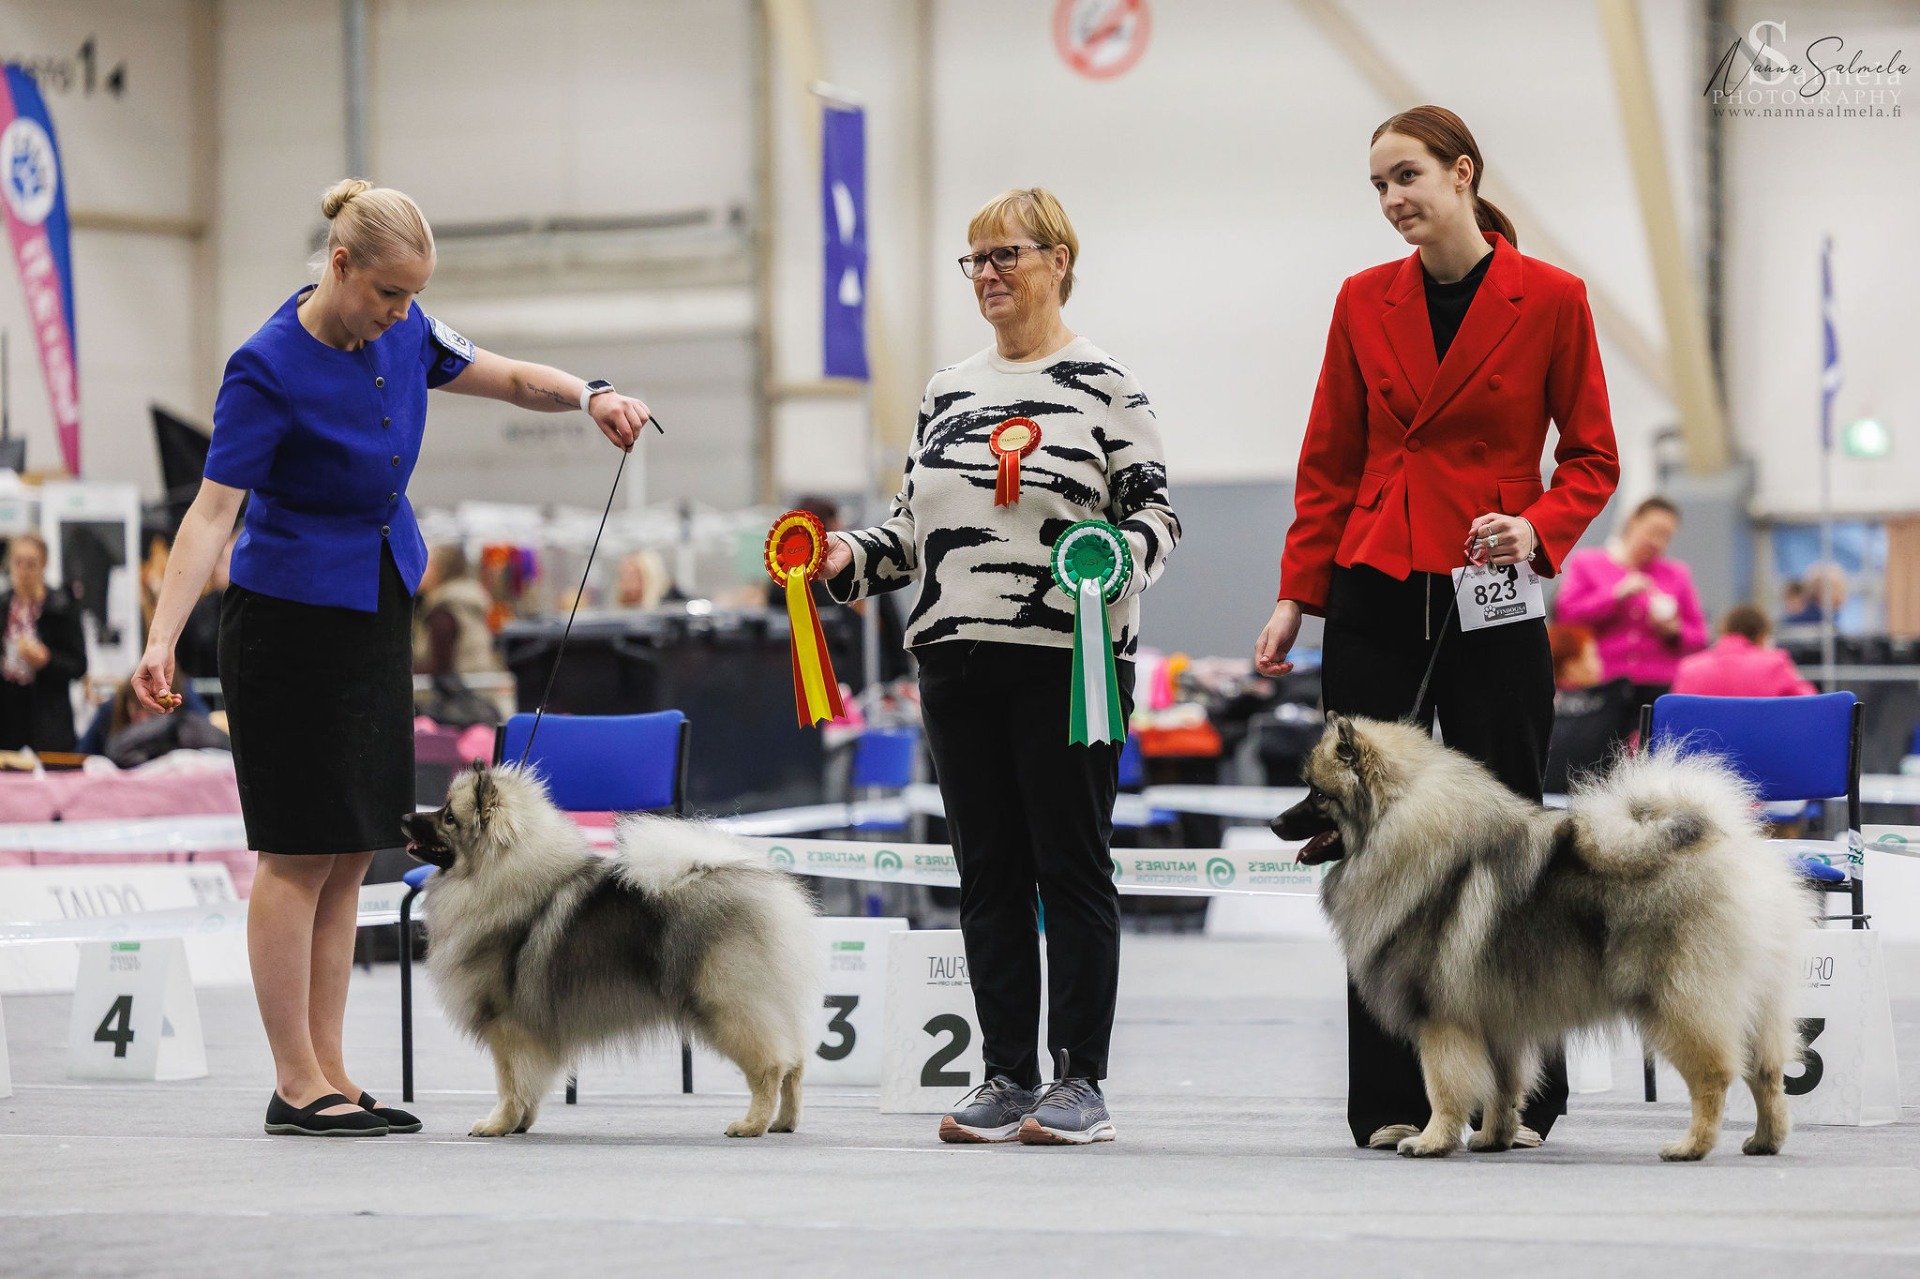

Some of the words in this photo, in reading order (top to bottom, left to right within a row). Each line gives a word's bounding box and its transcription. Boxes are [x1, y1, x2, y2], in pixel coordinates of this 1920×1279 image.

[1474, 580, 1517, 605] 823
[94, 995, 135, 1058] 4
[816, 994, 860, 1061] 3
[920, 1013, 971, 1087] 2
[1783, 1017, 1826, 1095] 3
